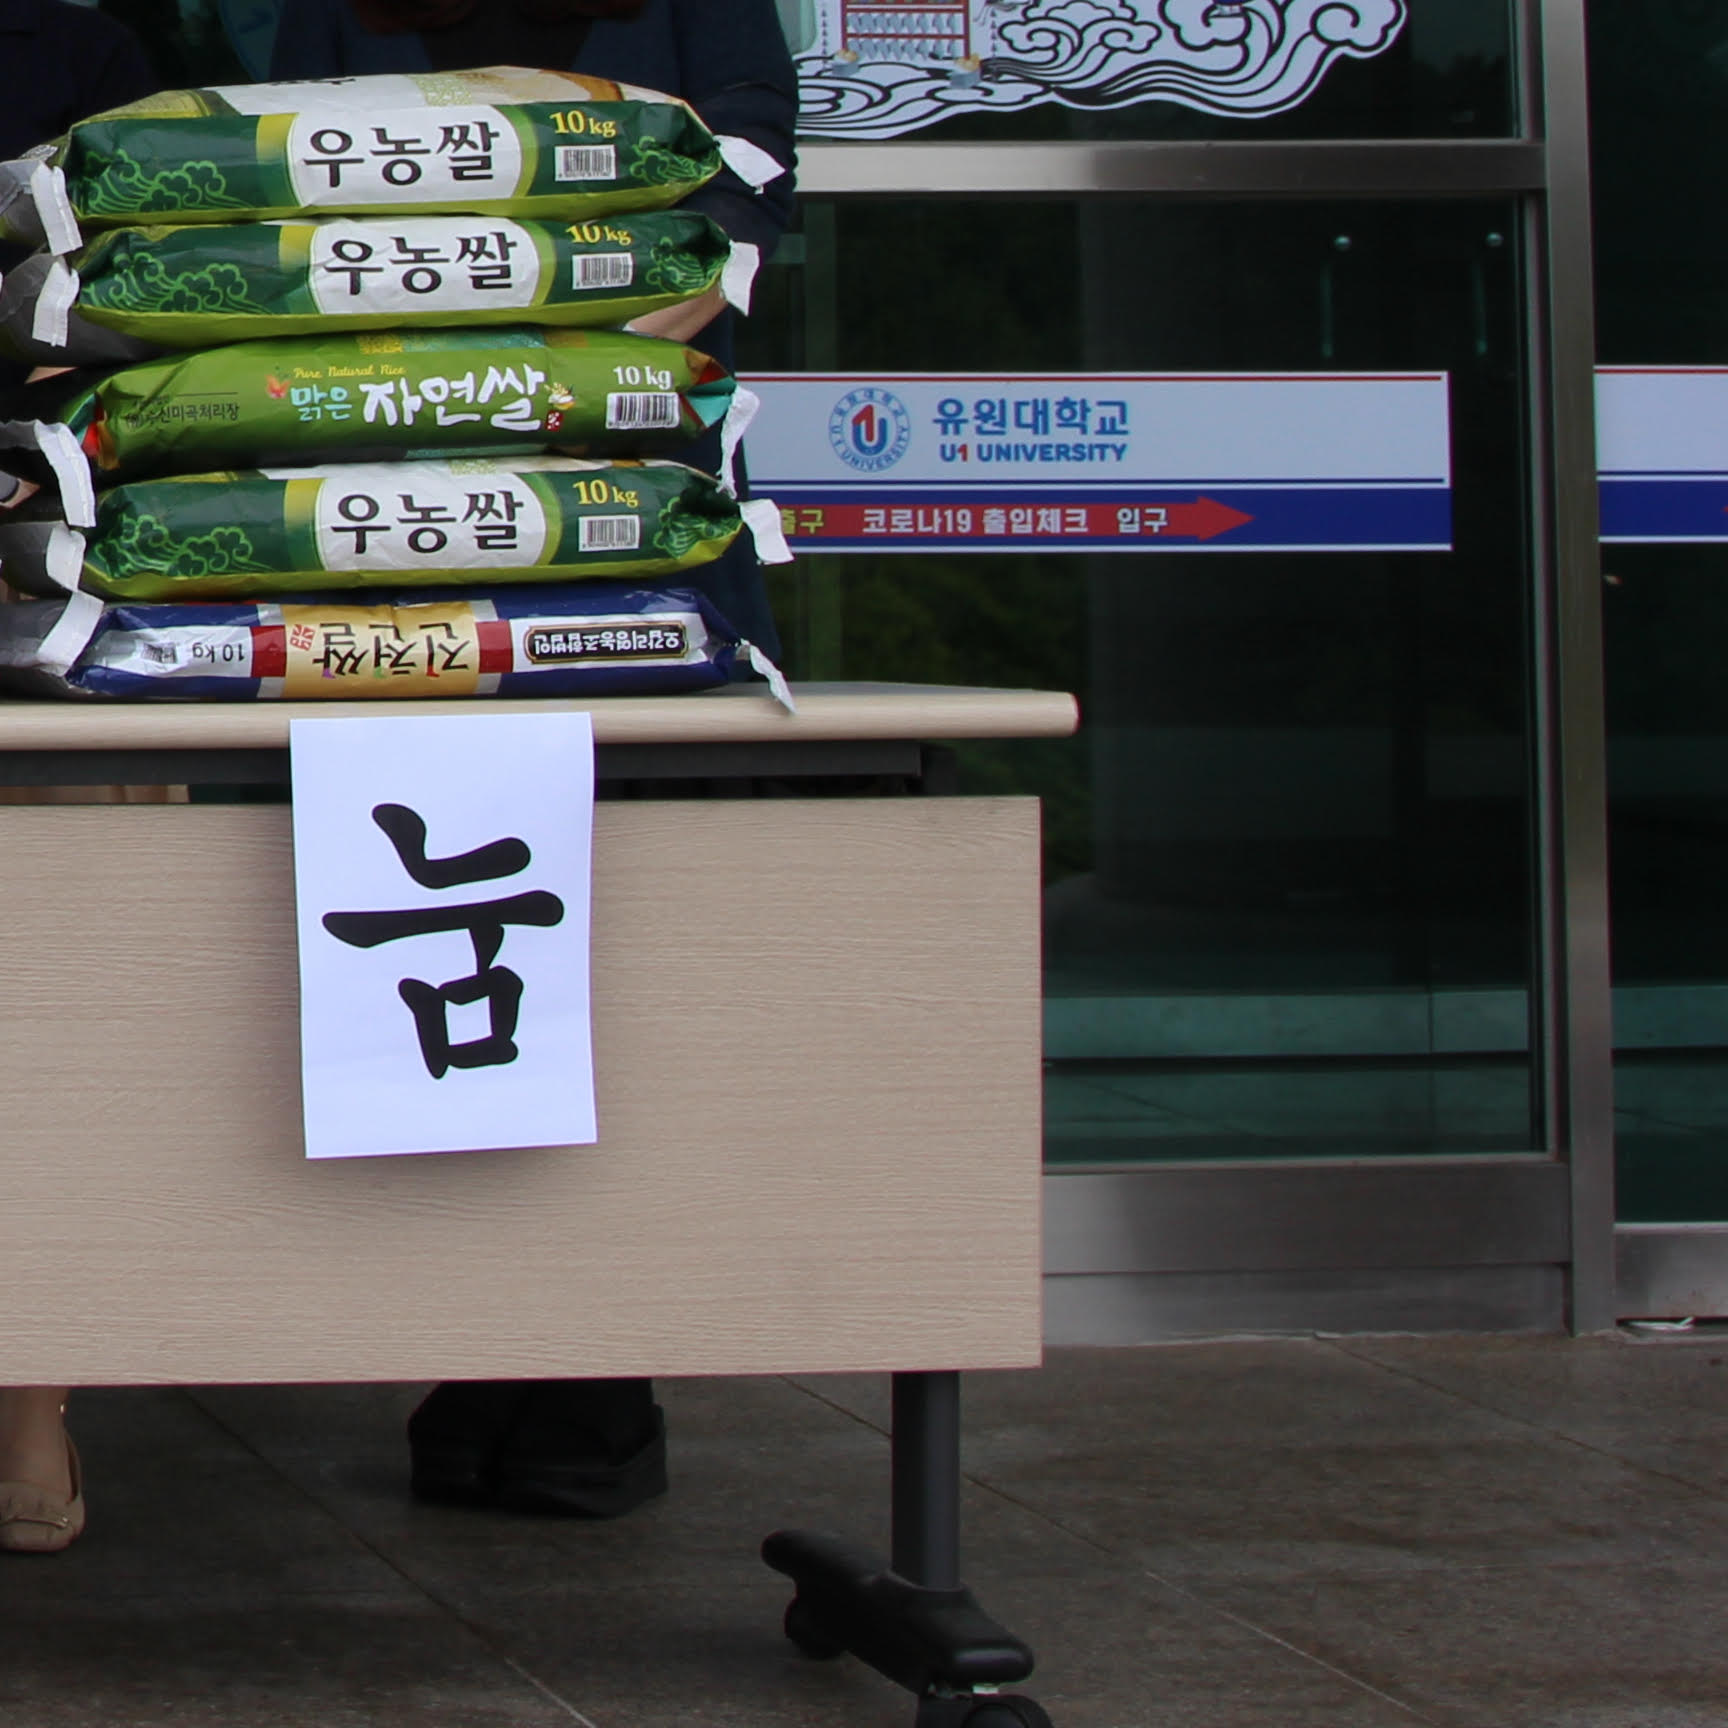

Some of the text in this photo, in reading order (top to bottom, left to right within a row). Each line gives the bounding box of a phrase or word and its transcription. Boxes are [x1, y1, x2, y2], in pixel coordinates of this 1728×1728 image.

[549, 110, 617, 138] 10 kg
[303, 121, 499, 188] 우농쌀
[323, 232, 517, 296] 우농쌀
[613, 366, 672, 389] 10 kg
[291, 363, 544, 431] 맑은 자연쌀
[933, 397, 1129, 437] 유원대학교
[940, 443, 1128, 463] U1 UNIVERSITY
[572, 479, 639, 509] 10 kg
[330, 492, 524, 554] 우농쌀
[862, 508, 1169, 535] 코로나19 출입체크 입구
[193, 641, 245, 661] 10 kg
[312, 623, 470, 679] 진천쌀
[534, 630, 681, 654] 오갑리영농조합법인
[321, 802, 565, 1080] 눔
